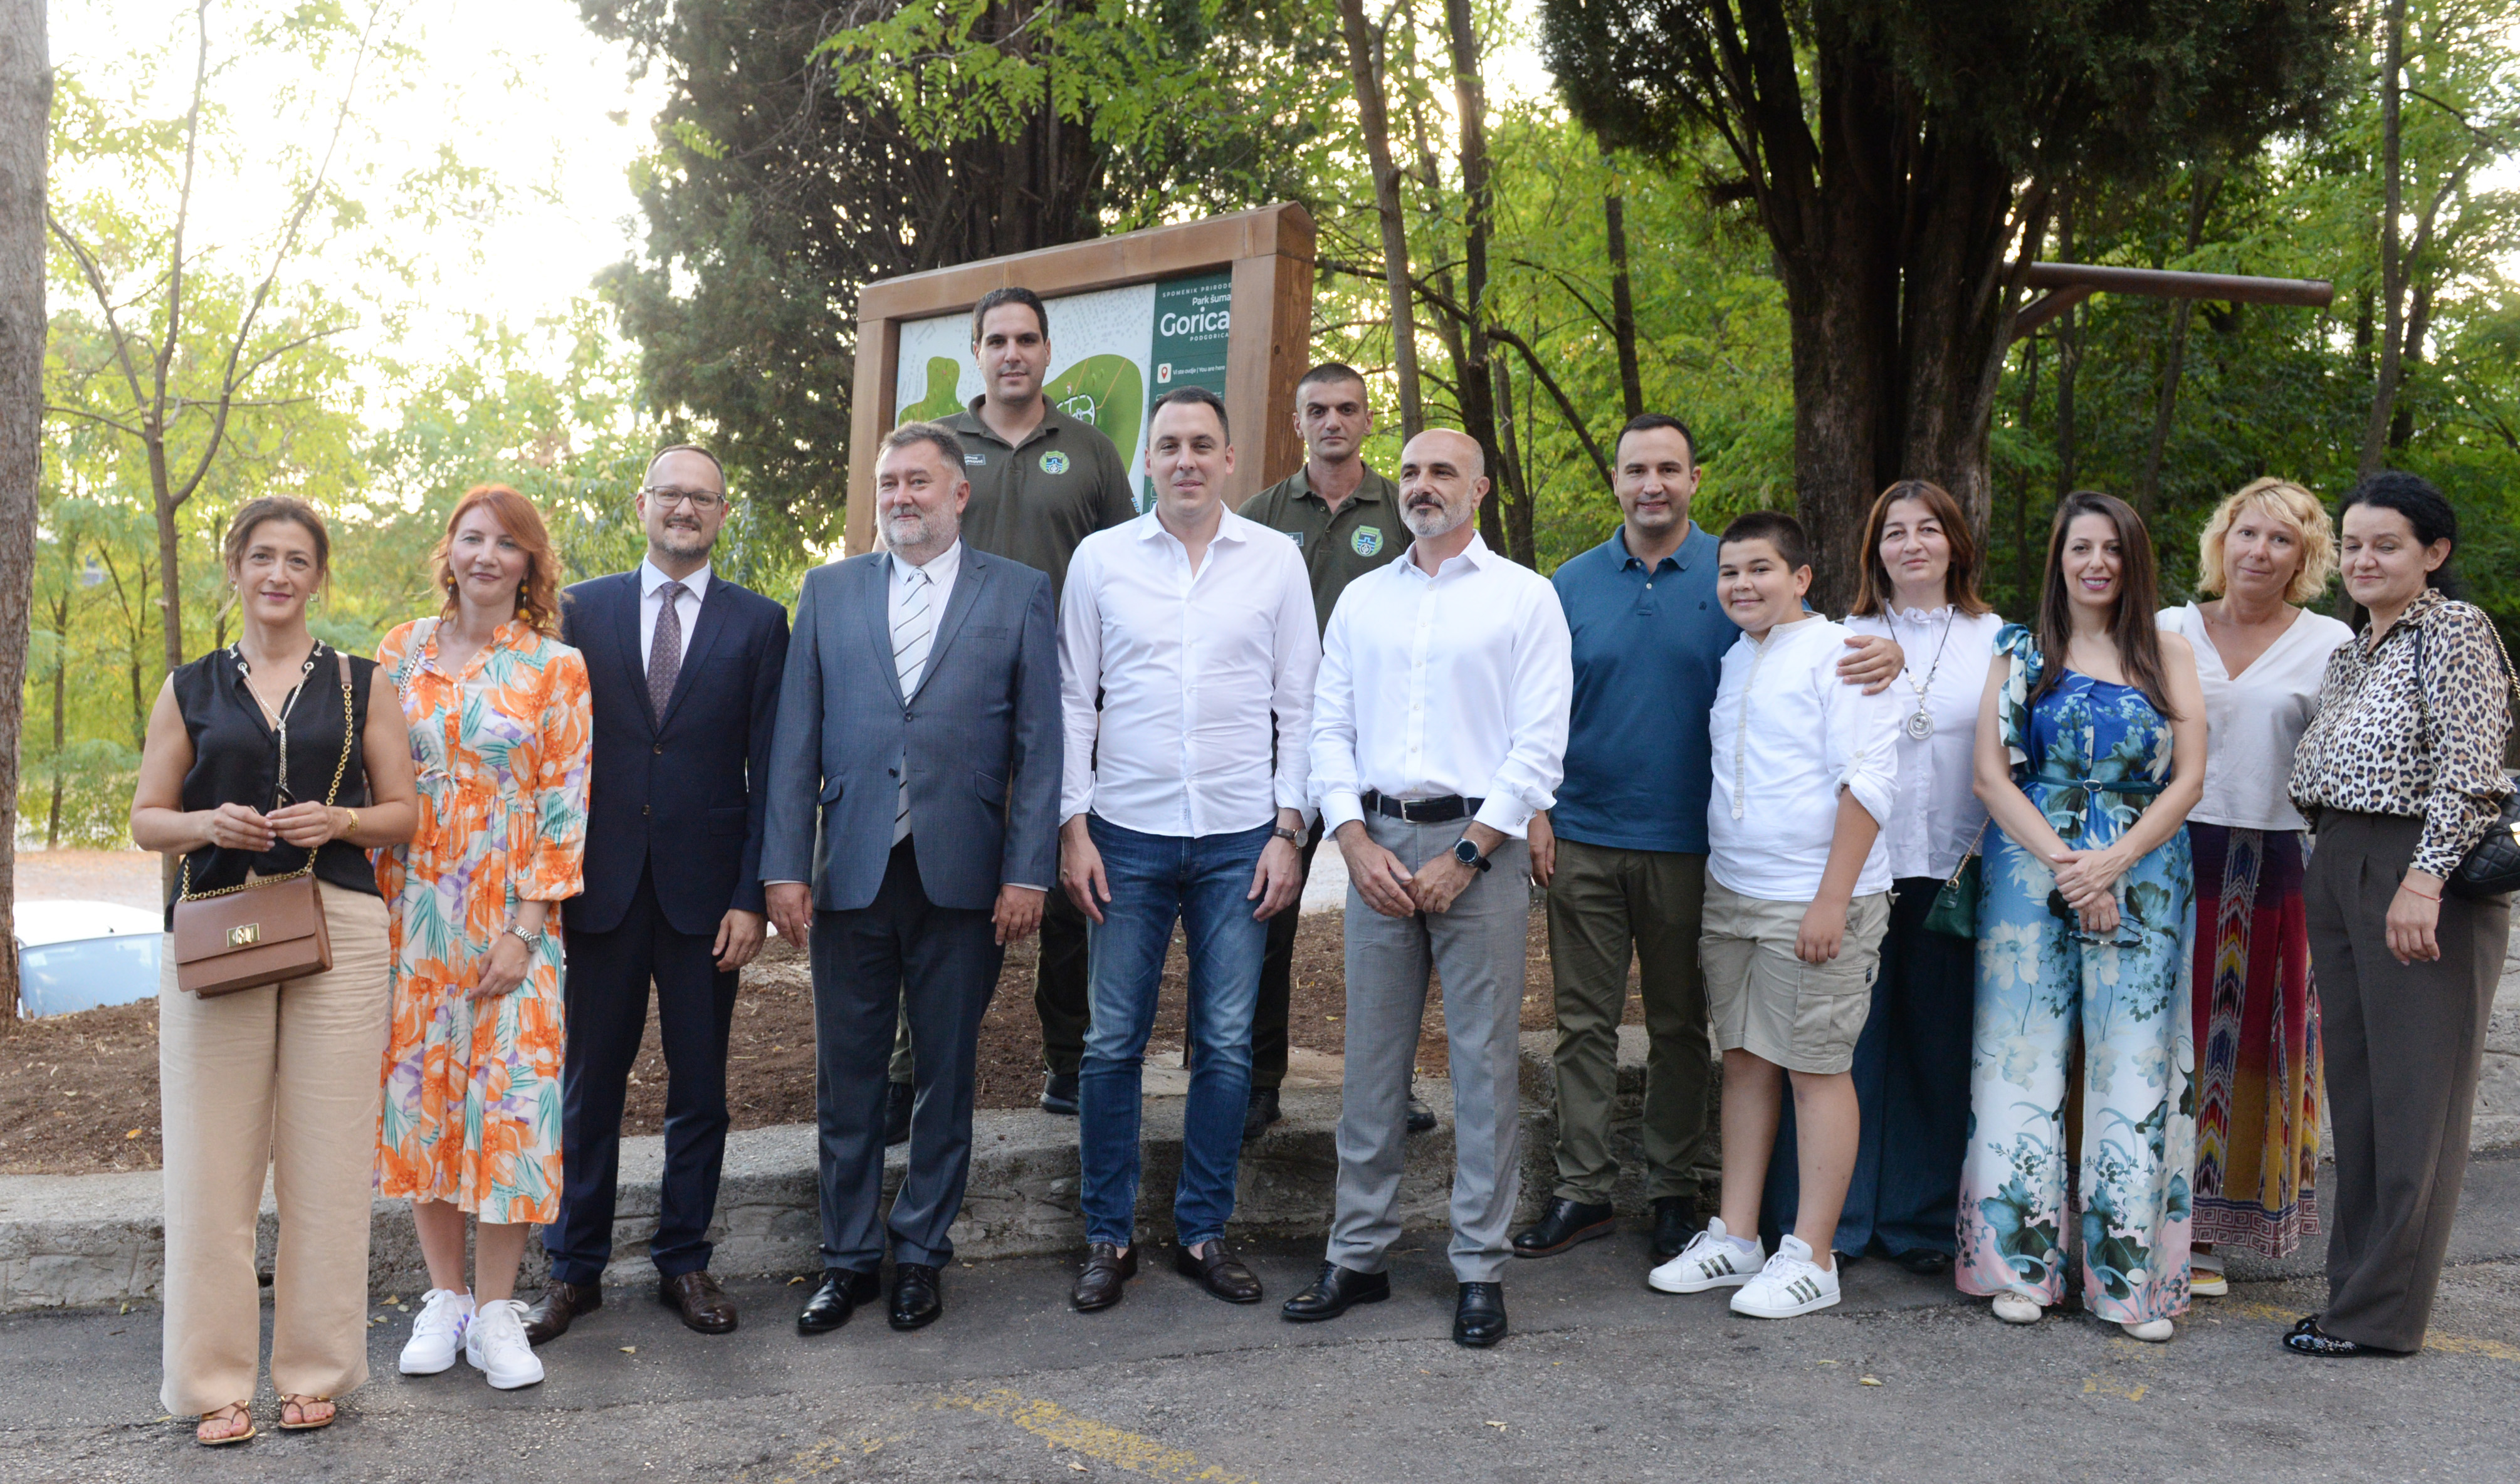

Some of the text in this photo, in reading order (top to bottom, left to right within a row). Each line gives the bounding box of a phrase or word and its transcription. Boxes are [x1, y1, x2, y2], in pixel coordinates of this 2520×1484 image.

[1163, 283, 1232, 298] SPOMENIK PRIRODE
[1192, 294, 1231, 306] Park šuma
[1160, 306, 1231, 337] Gorica
[1190, 333, 1229, 342] PODGORICA
